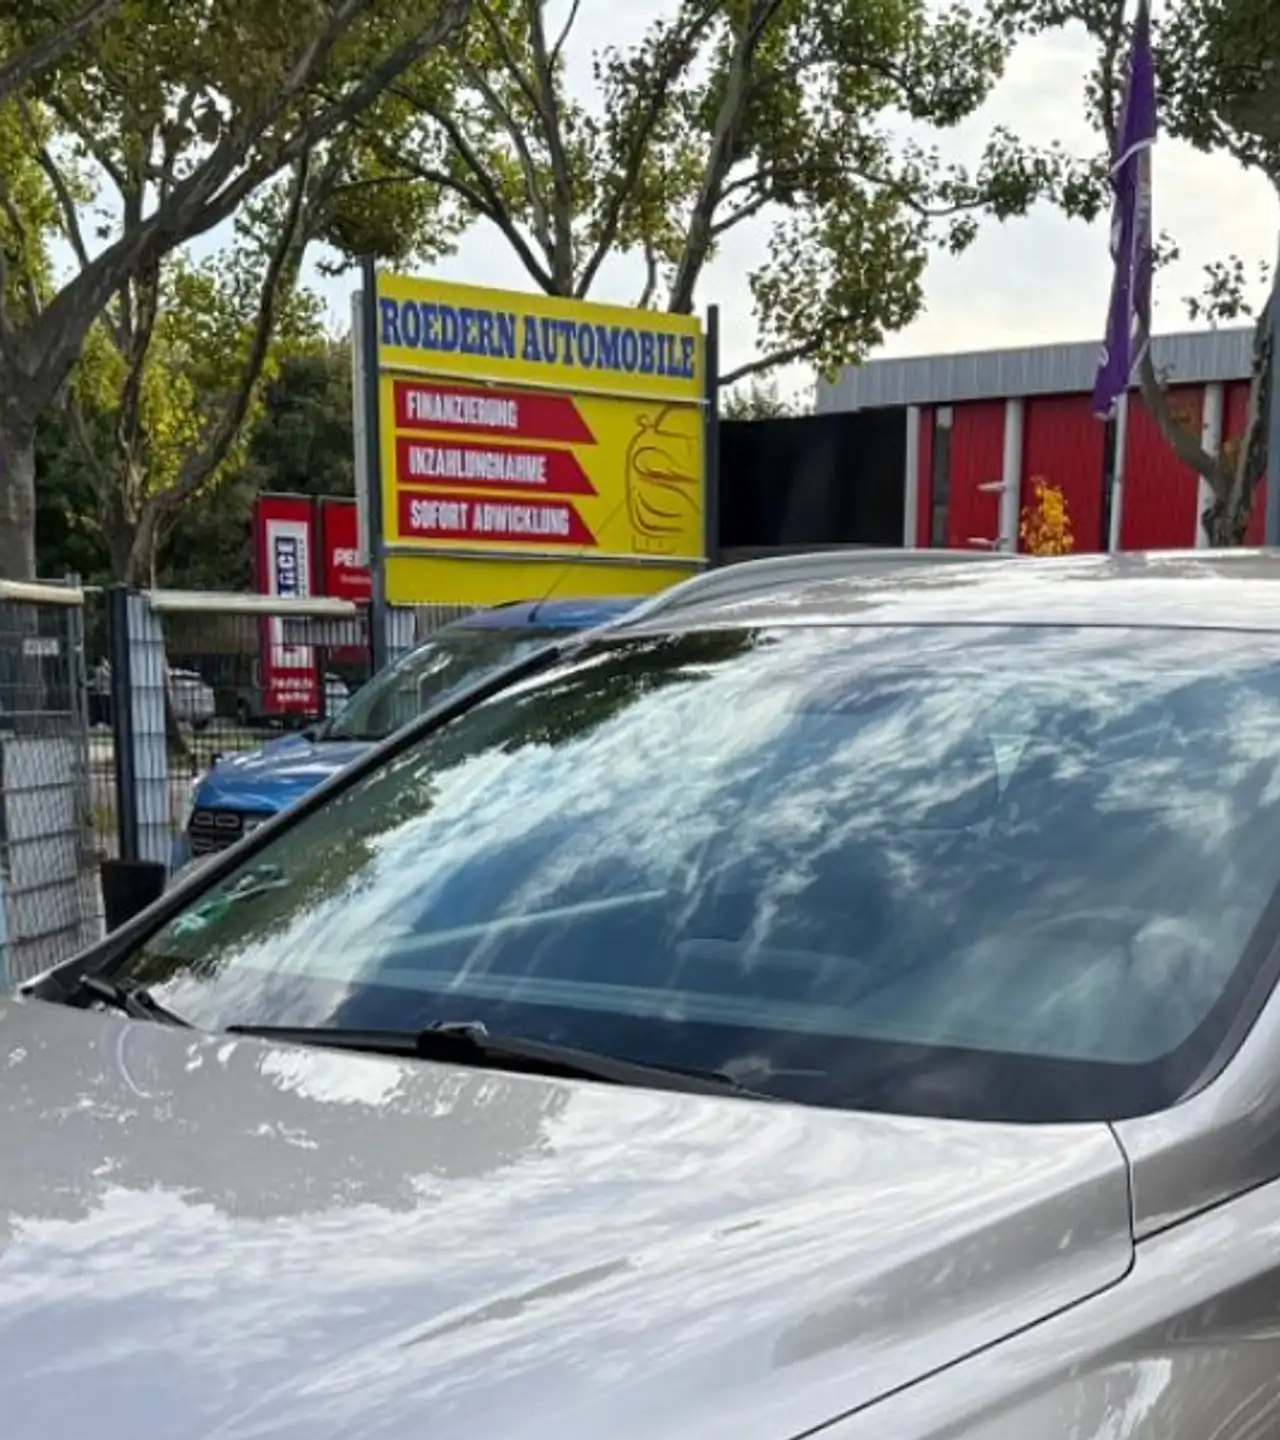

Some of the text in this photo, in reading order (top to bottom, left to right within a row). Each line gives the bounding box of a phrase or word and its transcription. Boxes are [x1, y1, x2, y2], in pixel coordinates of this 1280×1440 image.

[378, 297, 696, 379] ROEDERN AUTOMOBILE
[405, 389, 518, 428] FINANZIERUNG
[408, 445, 548, 484] INZAHLUNGNAHME
[410, 499, 570, 537] SOFORT ABWICKLUNG
